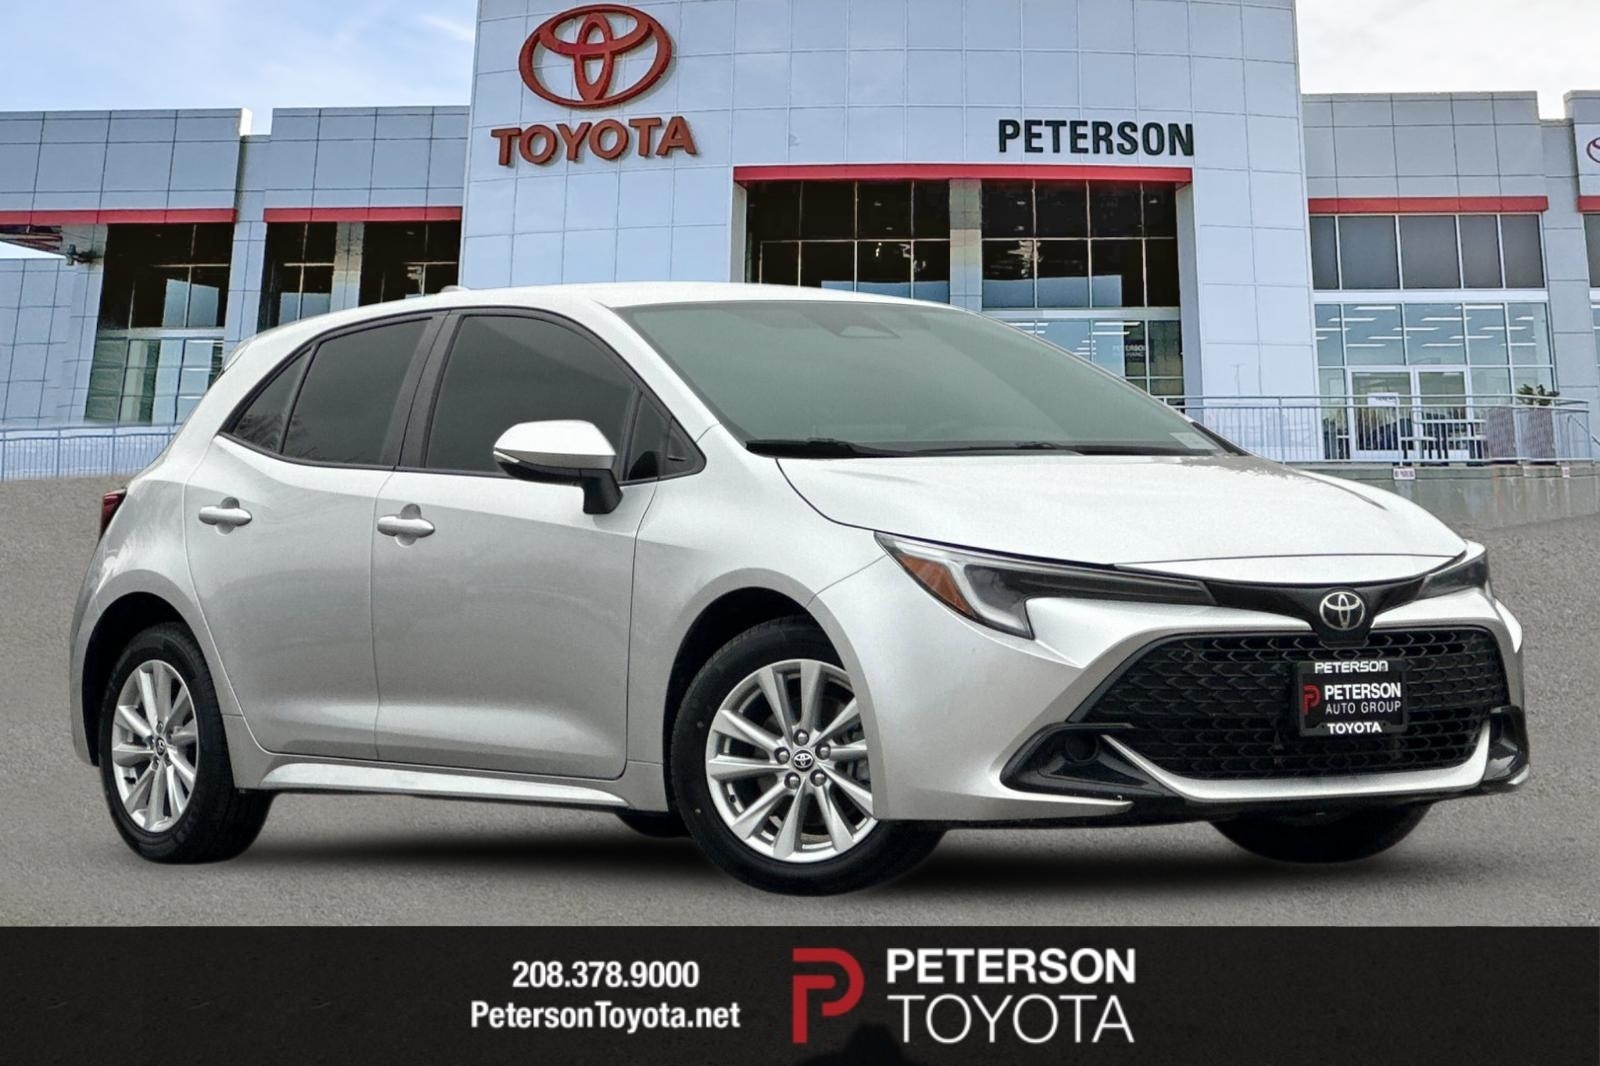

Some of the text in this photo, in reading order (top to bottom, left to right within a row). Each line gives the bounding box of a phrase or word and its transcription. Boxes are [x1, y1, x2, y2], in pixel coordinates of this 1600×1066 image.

[490, 116, 697, 166] TOYOTA
[998, 119, 1194, 156] PETERSON
[1324, 682, 1401, 700] PETERSON
[1325, 701, 1401, 715] AUTO GROUP
[1327, 721, 1383, 734] TOYOTA
